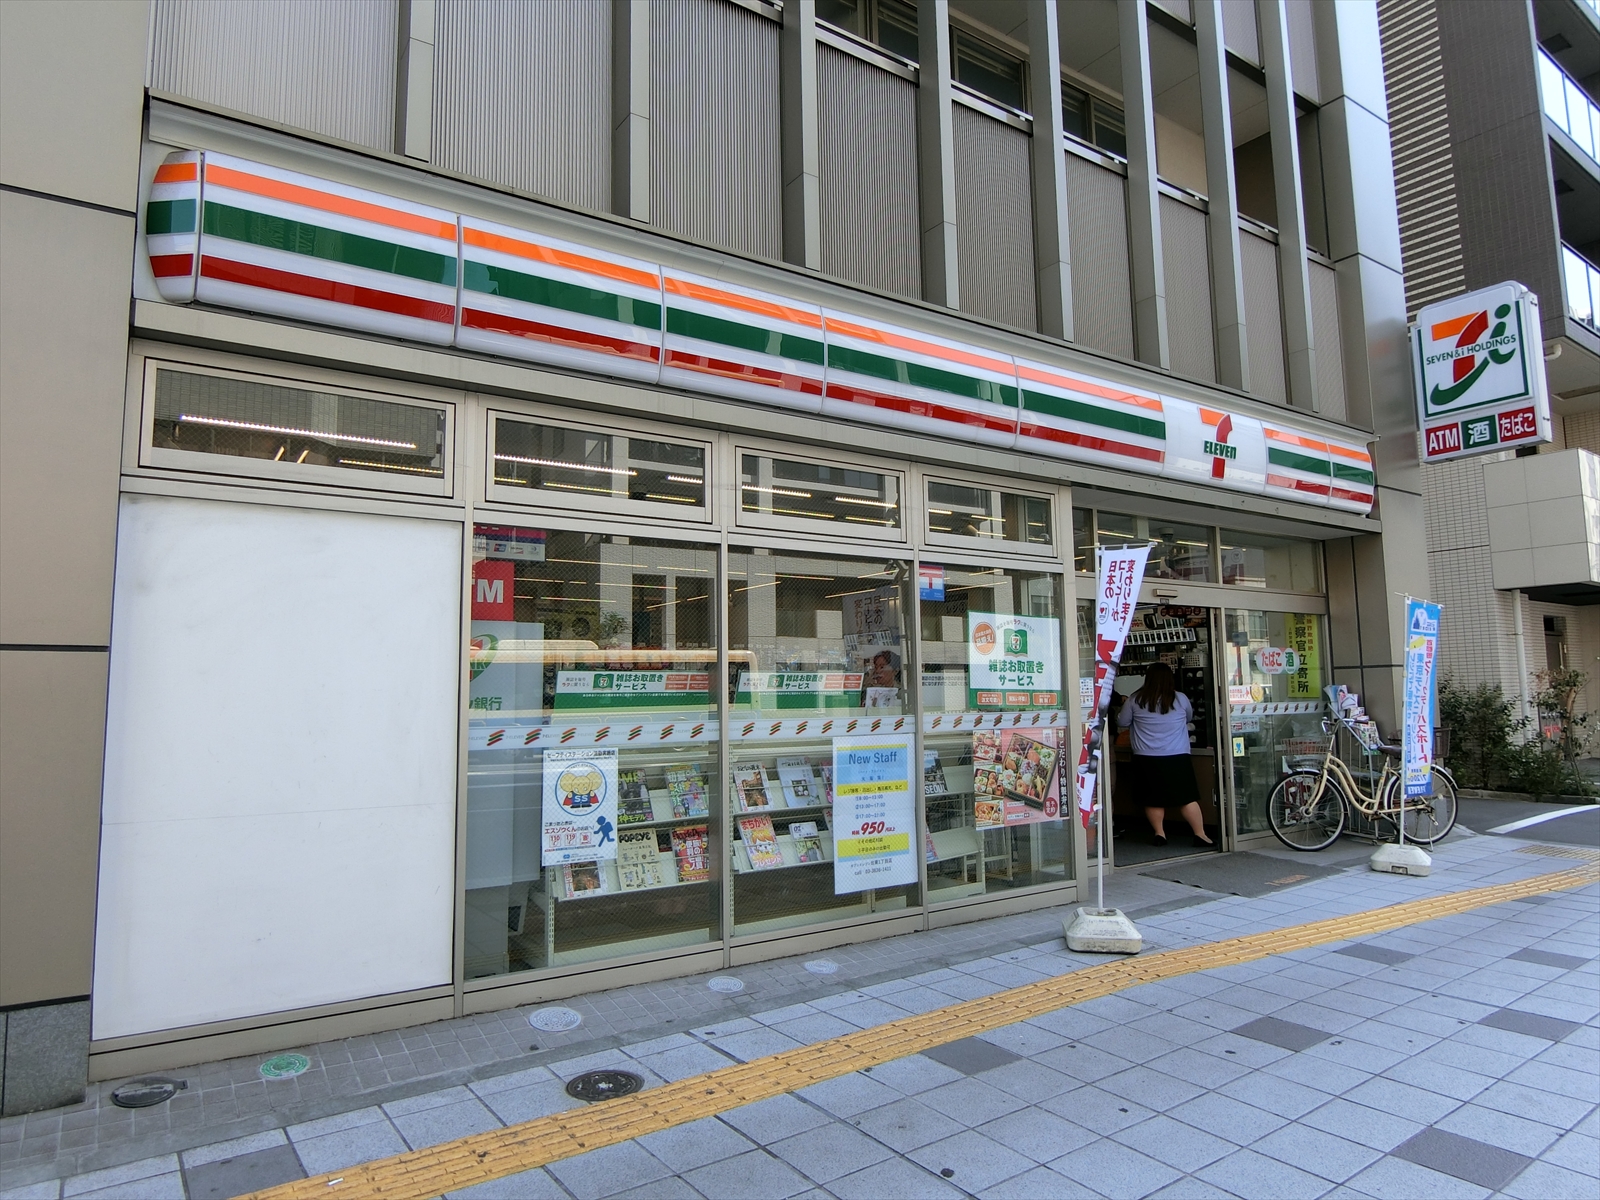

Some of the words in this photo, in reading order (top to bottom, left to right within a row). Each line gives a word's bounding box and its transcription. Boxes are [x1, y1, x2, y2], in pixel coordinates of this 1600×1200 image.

[1466, 334, 1517, 355] HOLDINGS
[1500, 412, 1535, 438] たばこ
[1428, 427, 1458, 452] ATM
[1468, 420, 1490, 445] 酒
[1261, 651, 1282, 668] たばこ
[1285, 651, 1294, 668] 酒
[1294, 613, 1309, 693] 警察官立寄所
[988, 659, 1044, 674] 雑誌お取置き
[616, 673, 664, 683] 雑誌お取置き
[785, 674, 823, 682] 雑誌お取置き
[998, 675, 1034, 686] サービス
[615, 683, 647, 691] サービス
[785, 682, 810, 690] サービス
[848, 753, 871, 765] New
[873, 751, 897, 763] Staff
[861, 821, 885, 835] 950
[619, 831, 652, 844] POPEYE
